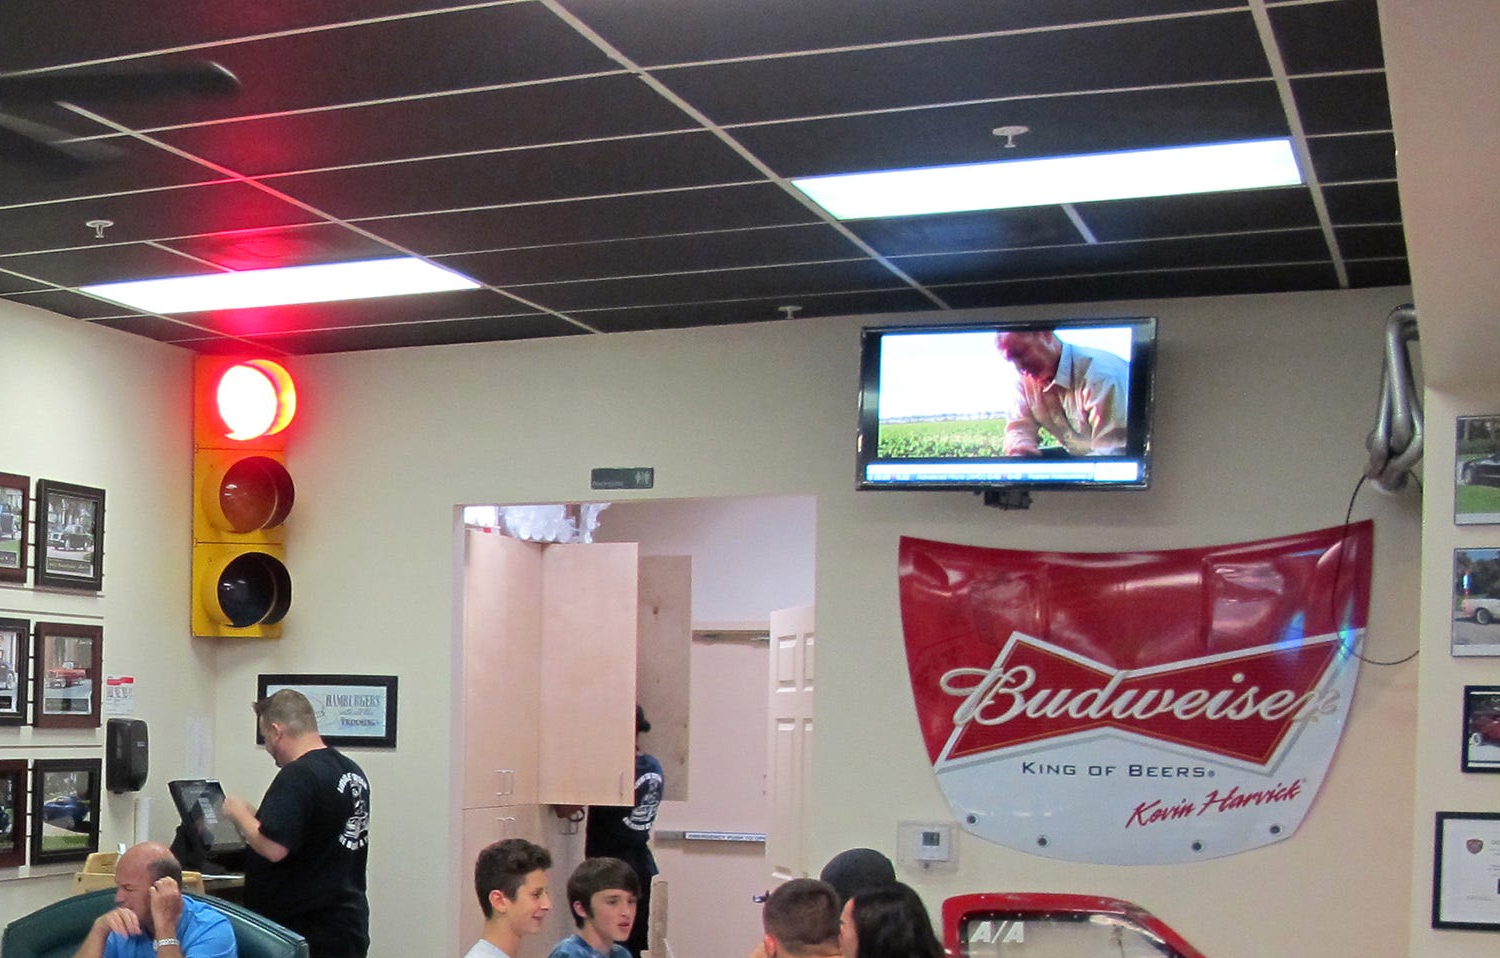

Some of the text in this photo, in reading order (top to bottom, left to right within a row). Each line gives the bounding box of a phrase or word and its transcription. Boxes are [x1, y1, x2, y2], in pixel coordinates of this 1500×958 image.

[939, 665, 1341, 727] Budweiser
[1022, 761, 1076, 777] KING
[1088, 764, 1116, 777] OF
[1197, 777, 1302, 816] Harvick
